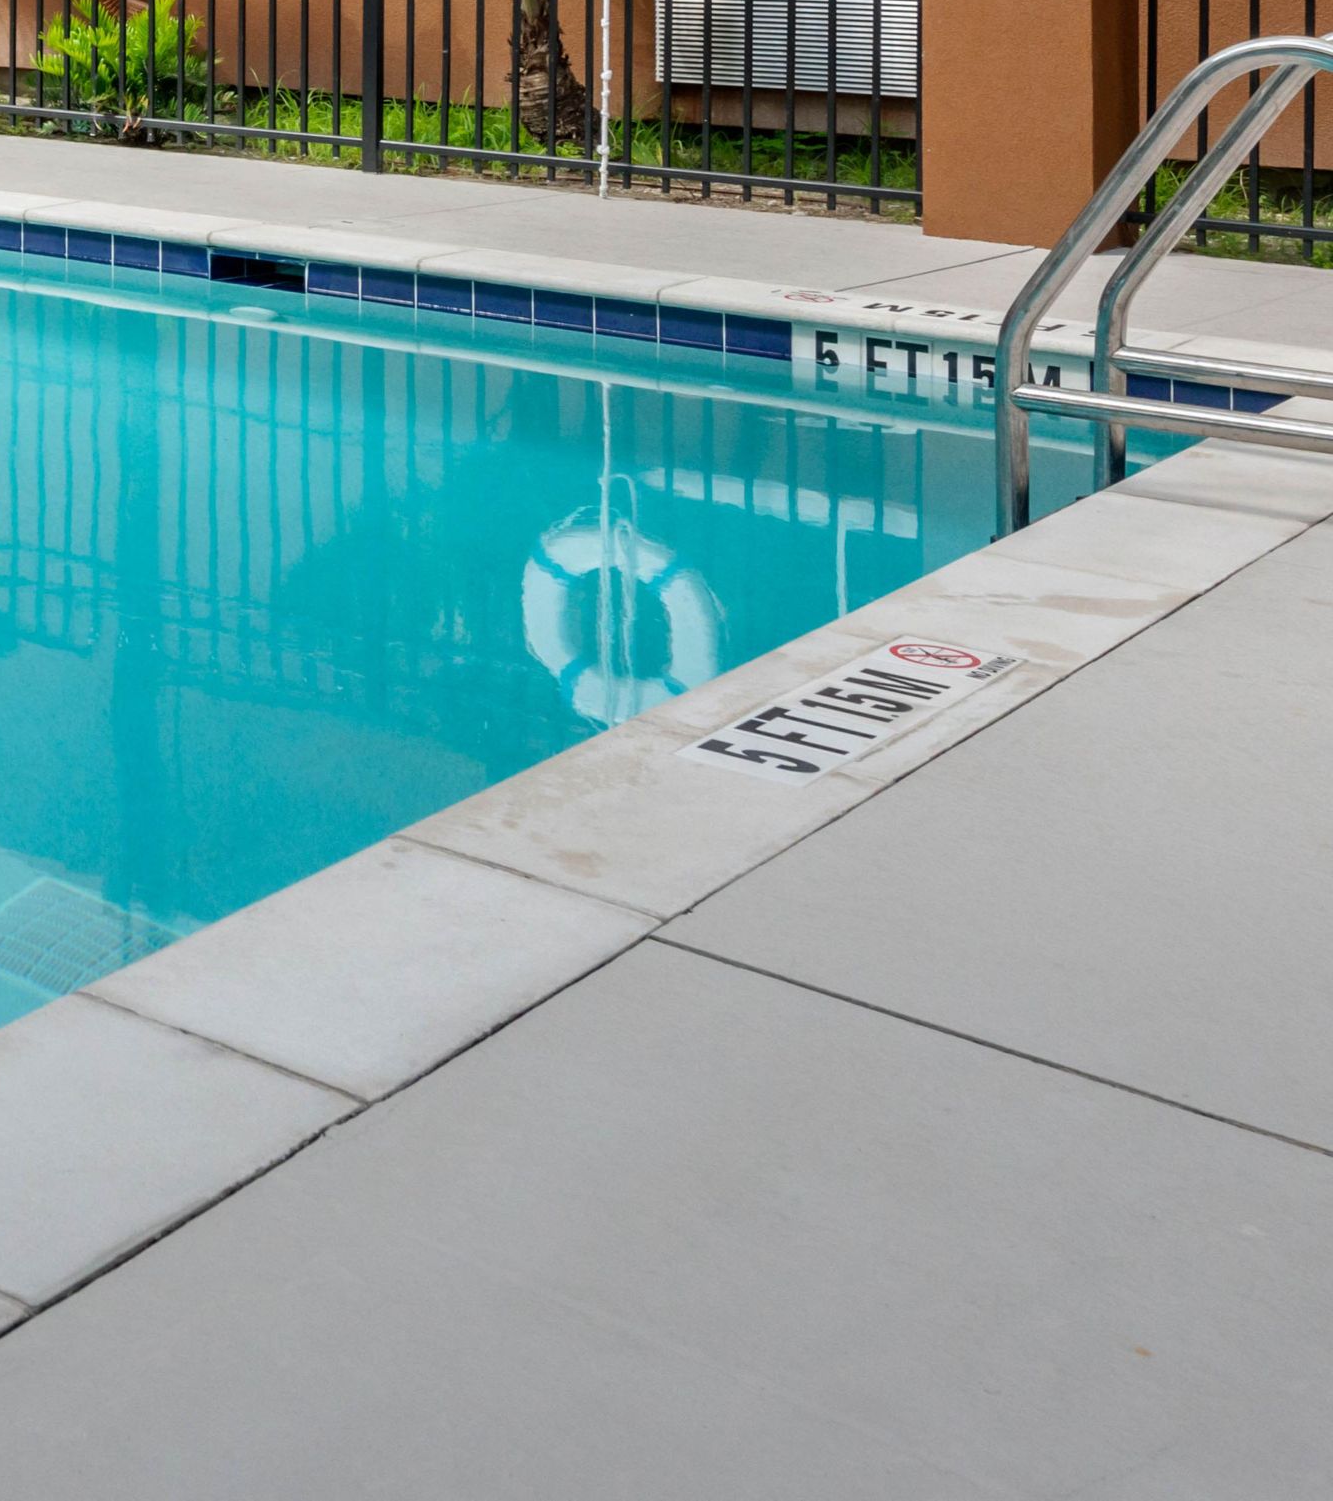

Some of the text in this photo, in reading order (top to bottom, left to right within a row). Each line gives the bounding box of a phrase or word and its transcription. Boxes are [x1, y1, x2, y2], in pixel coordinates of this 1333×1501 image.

[815, 331, 840, 366] 5
[866, 337, 929, 379] FT
[843, 668, 951, 700] M
[734, 706, 877, 756] FT
[697, 739, 821, 774] 5
